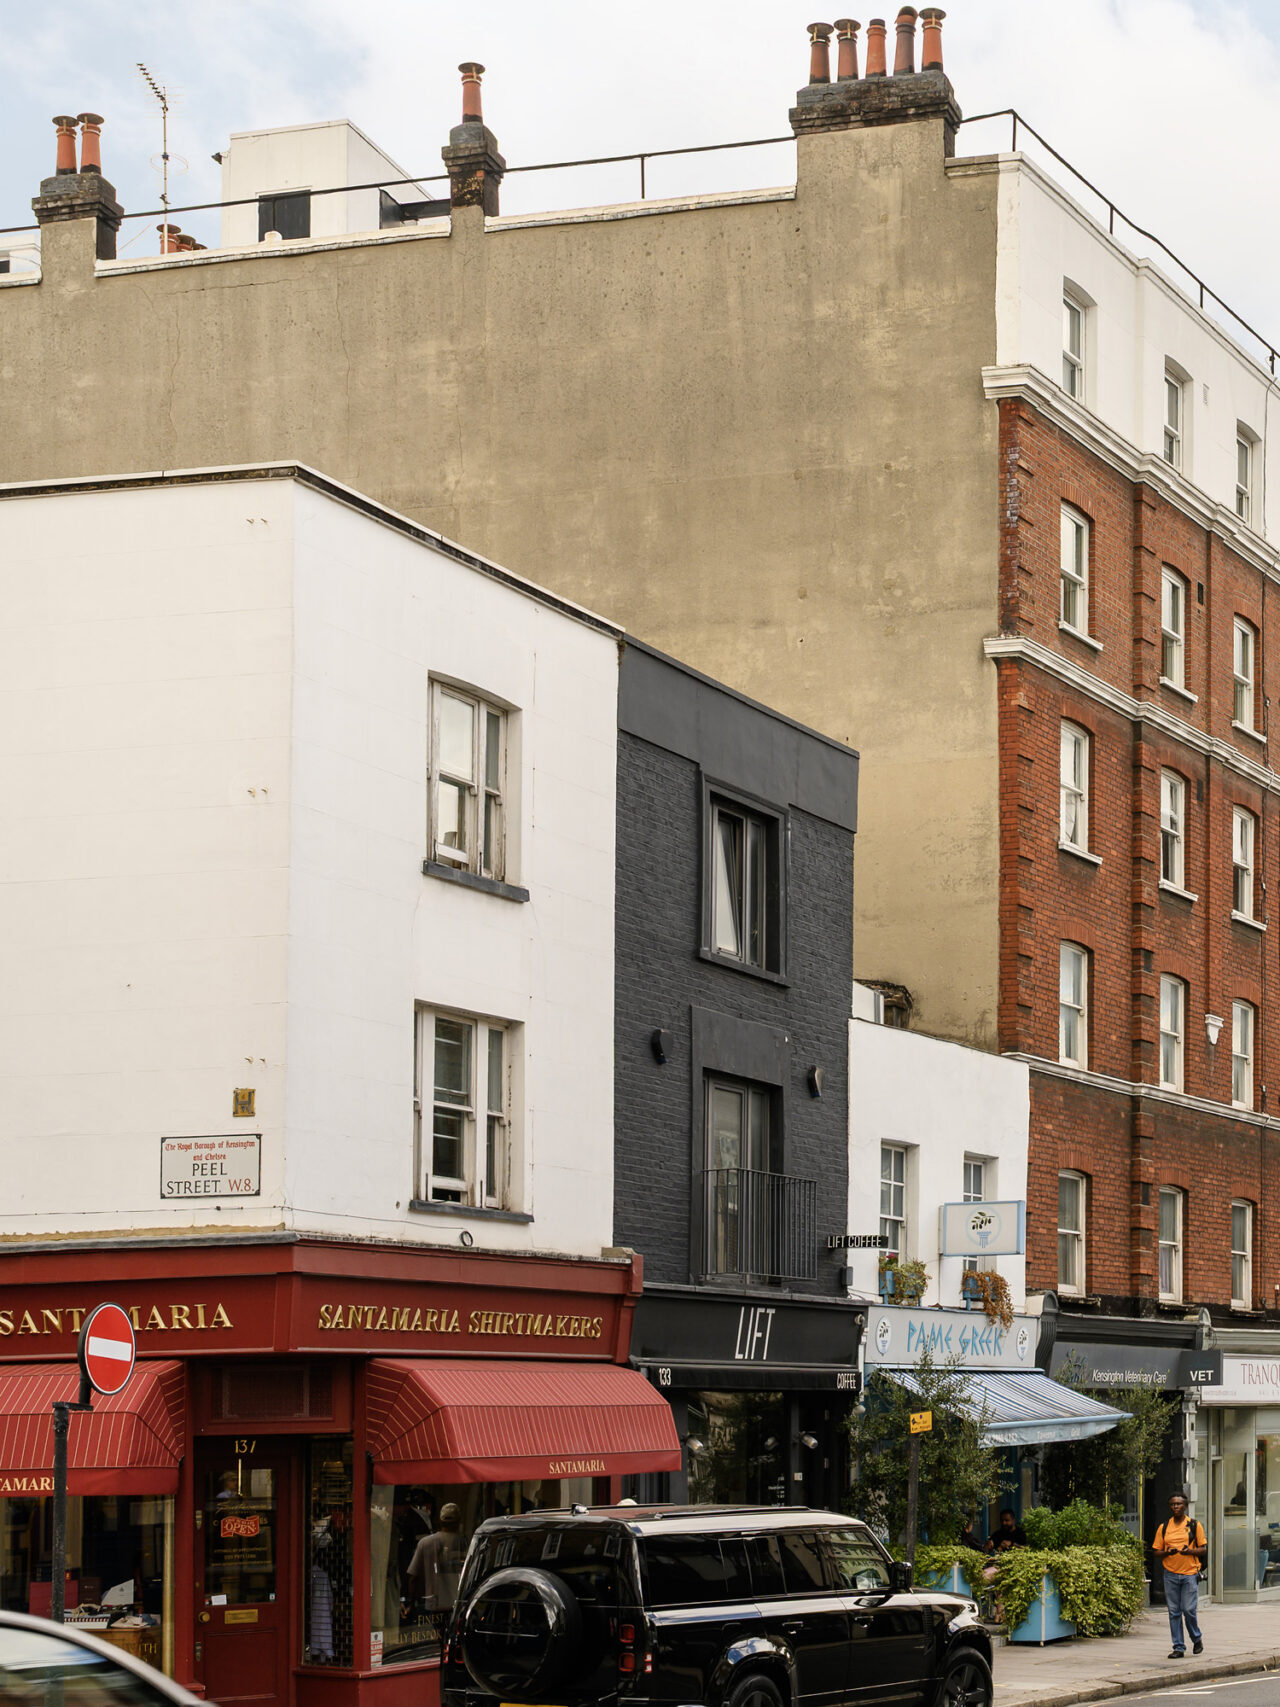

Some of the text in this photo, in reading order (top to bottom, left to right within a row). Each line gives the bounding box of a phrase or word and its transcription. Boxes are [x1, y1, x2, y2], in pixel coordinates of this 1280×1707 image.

[178, 1143, 192, 1152] Royal
[195, 1142, 215, 1151] Borough
[226, 1141, 255, 1149] Kensington
[192, 1162, 227, 1176] PEEL
[827, 1235, 881, 1248] LIFT COFFEE
[318, 1304, 603, 1338] SANTAMARIA SHIRTMAKERS
[735, 1306, 776, 1361] LIFT
[907, 1320, 1003, 1356] PAME GREEK
[659, 1368, 671, 1386] 133
[837, 1373, 857, 1389] COFFEE
[1092, 1369, 1167, 1385] Kensington Veterinary Care
[1190, 1370, 1214, 1381] VET
[549, 1460, 606, 1474] SANTAMARIA
[0, 1476, 69, 1491] AMARI
[225, 1521, 255, 1534] OPEN
